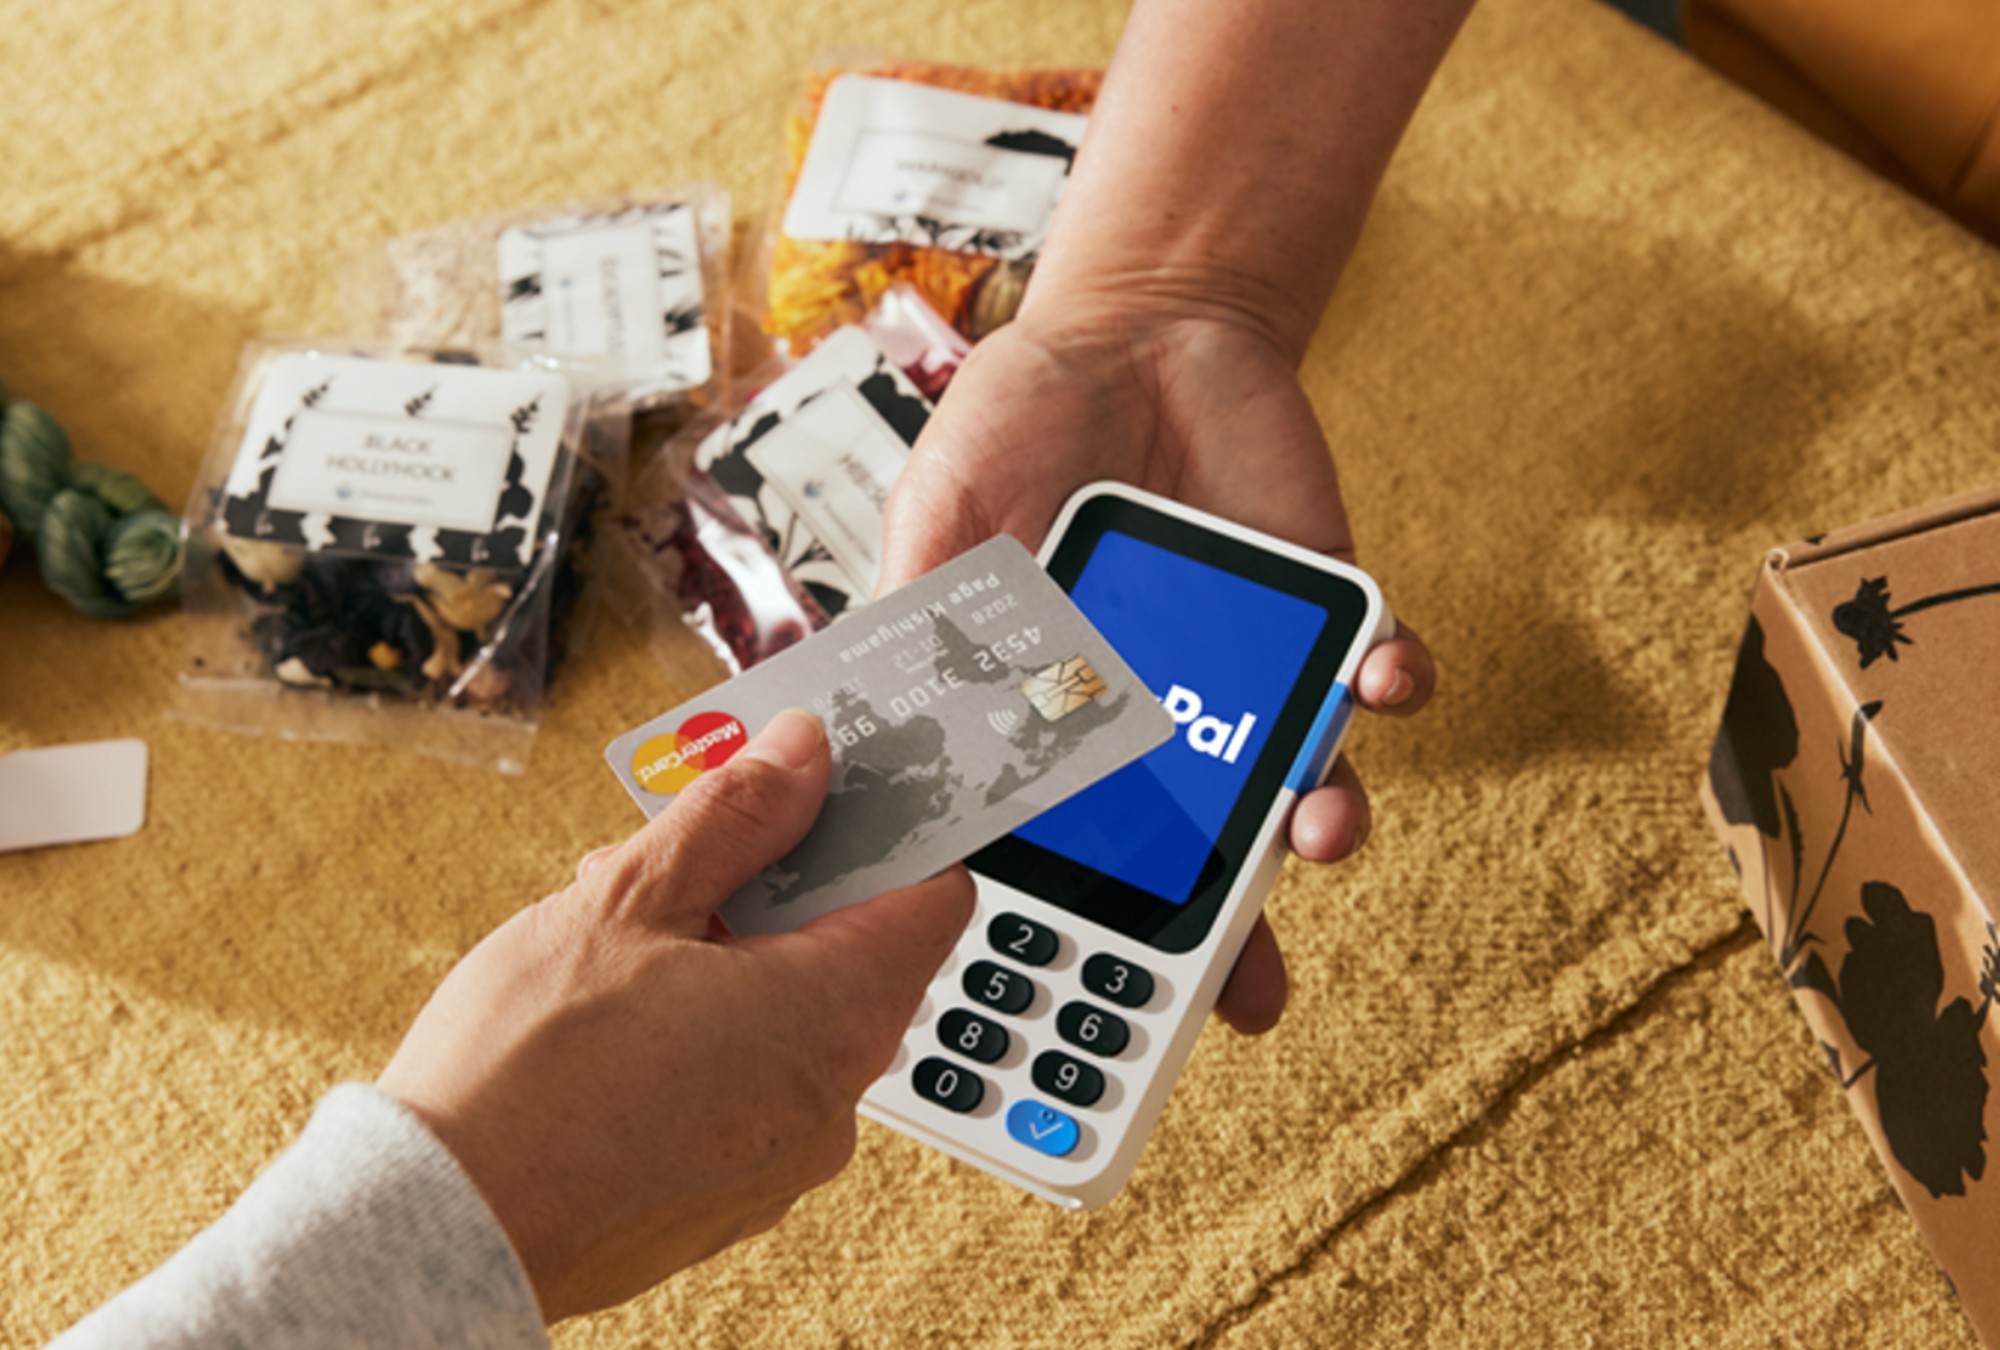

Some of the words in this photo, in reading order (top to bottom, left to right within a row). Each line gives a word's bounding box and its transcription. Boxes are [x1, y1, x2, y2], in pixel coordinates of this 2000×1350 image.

[948, 571, 1000, 605] Page
[839, 601, 947, 664] Kishiyama
[972, 626, 1042, 673] 4532
[889, 667, 964, 717] 3100
[1155, 684, 1257, 764] Pal
[639, 720, 741, 783] MasterCard
[1008, 924, 1034, 954] 2
[984, 971, 1009, 1000] 5
[1105, 965, 1128, 994] 3
[959, 1021, 983, 1049] 8
[1078, 1013, 1103, 1041] 6
[935, 1069, 958, 1097] 0
[1055, 1062, 1079, 1090] 9
